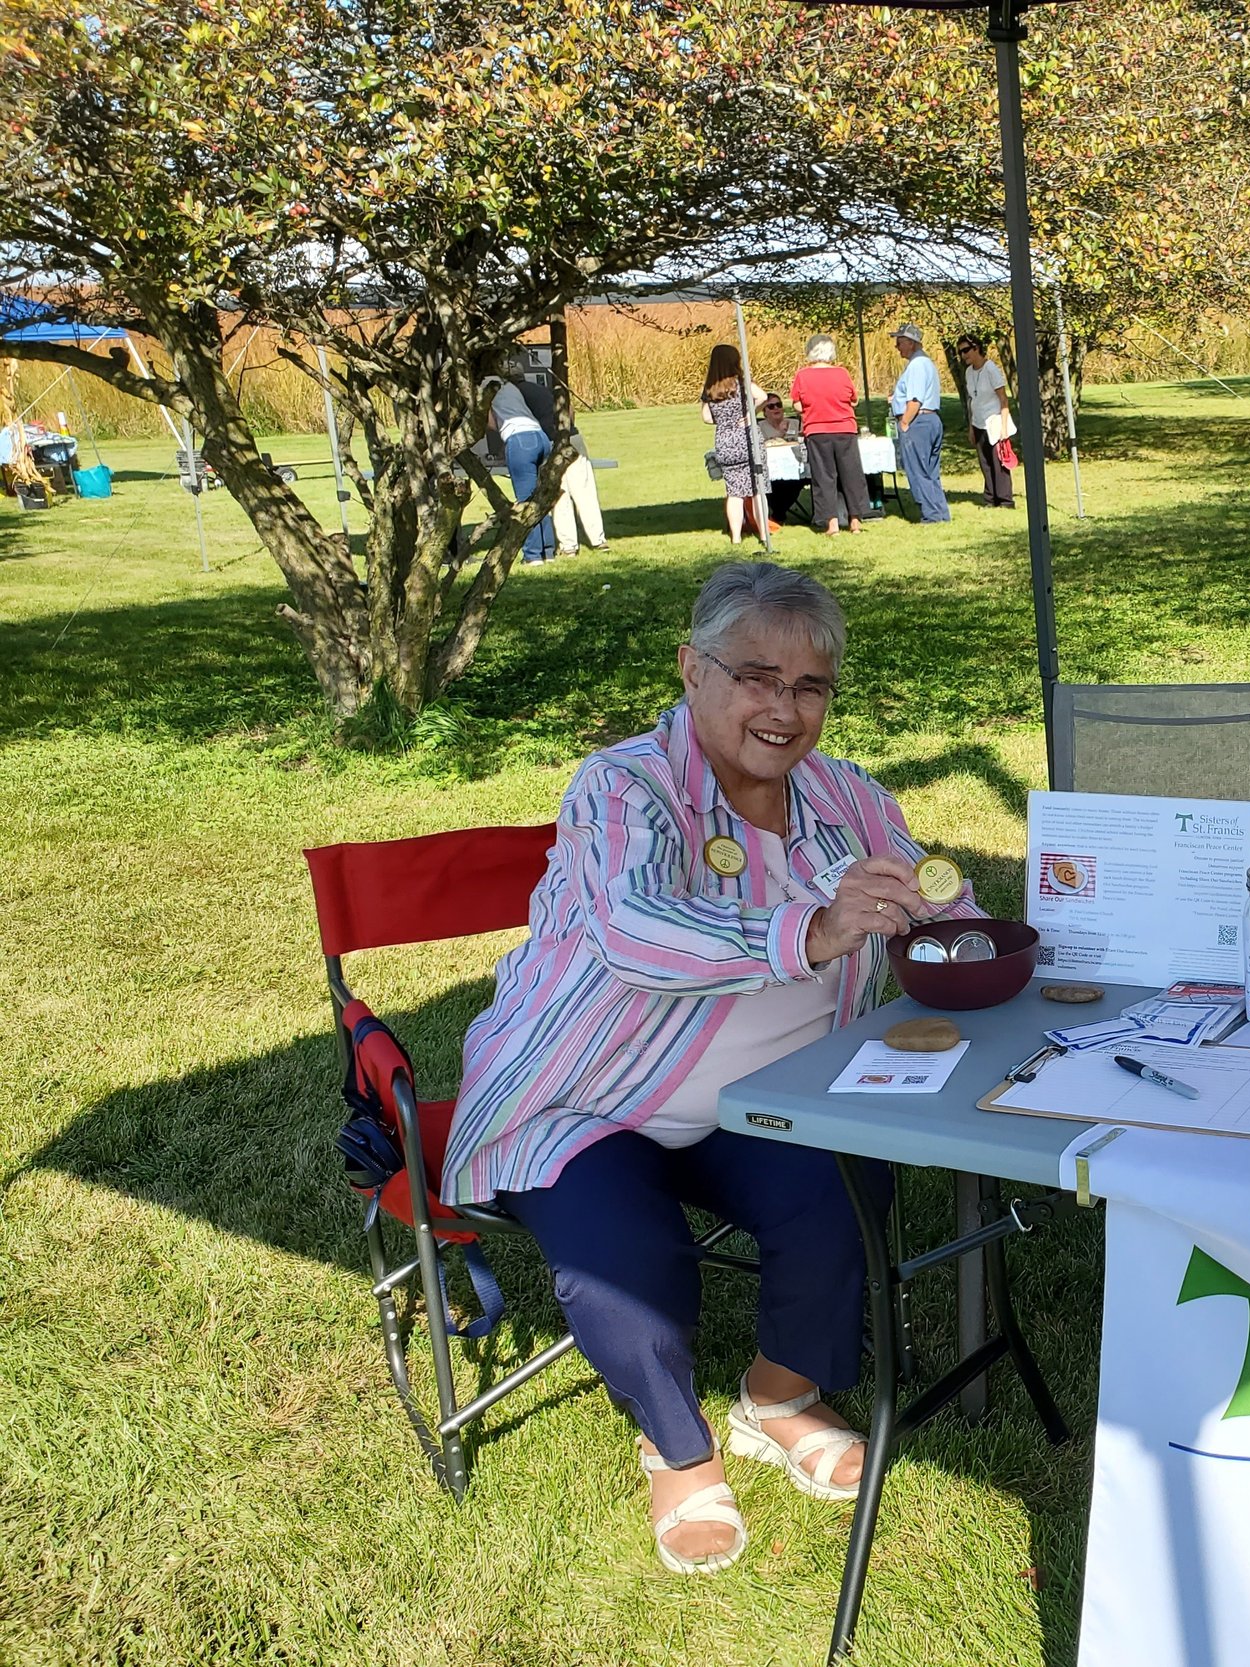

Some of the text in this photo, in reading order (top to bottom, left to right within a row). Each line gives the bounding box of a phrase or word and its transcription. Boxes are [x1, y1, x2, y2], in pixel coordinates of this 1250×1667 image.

[1200, 814, 1239, 829] Sisters of
[1192, 823, 1245, 837] St. Francis
[1174, 841, 1205, 850] Franciscan
[1064, 897, 1095, 905] Sandwiches
[751, 1116, 787, 1129] LIFETIME
